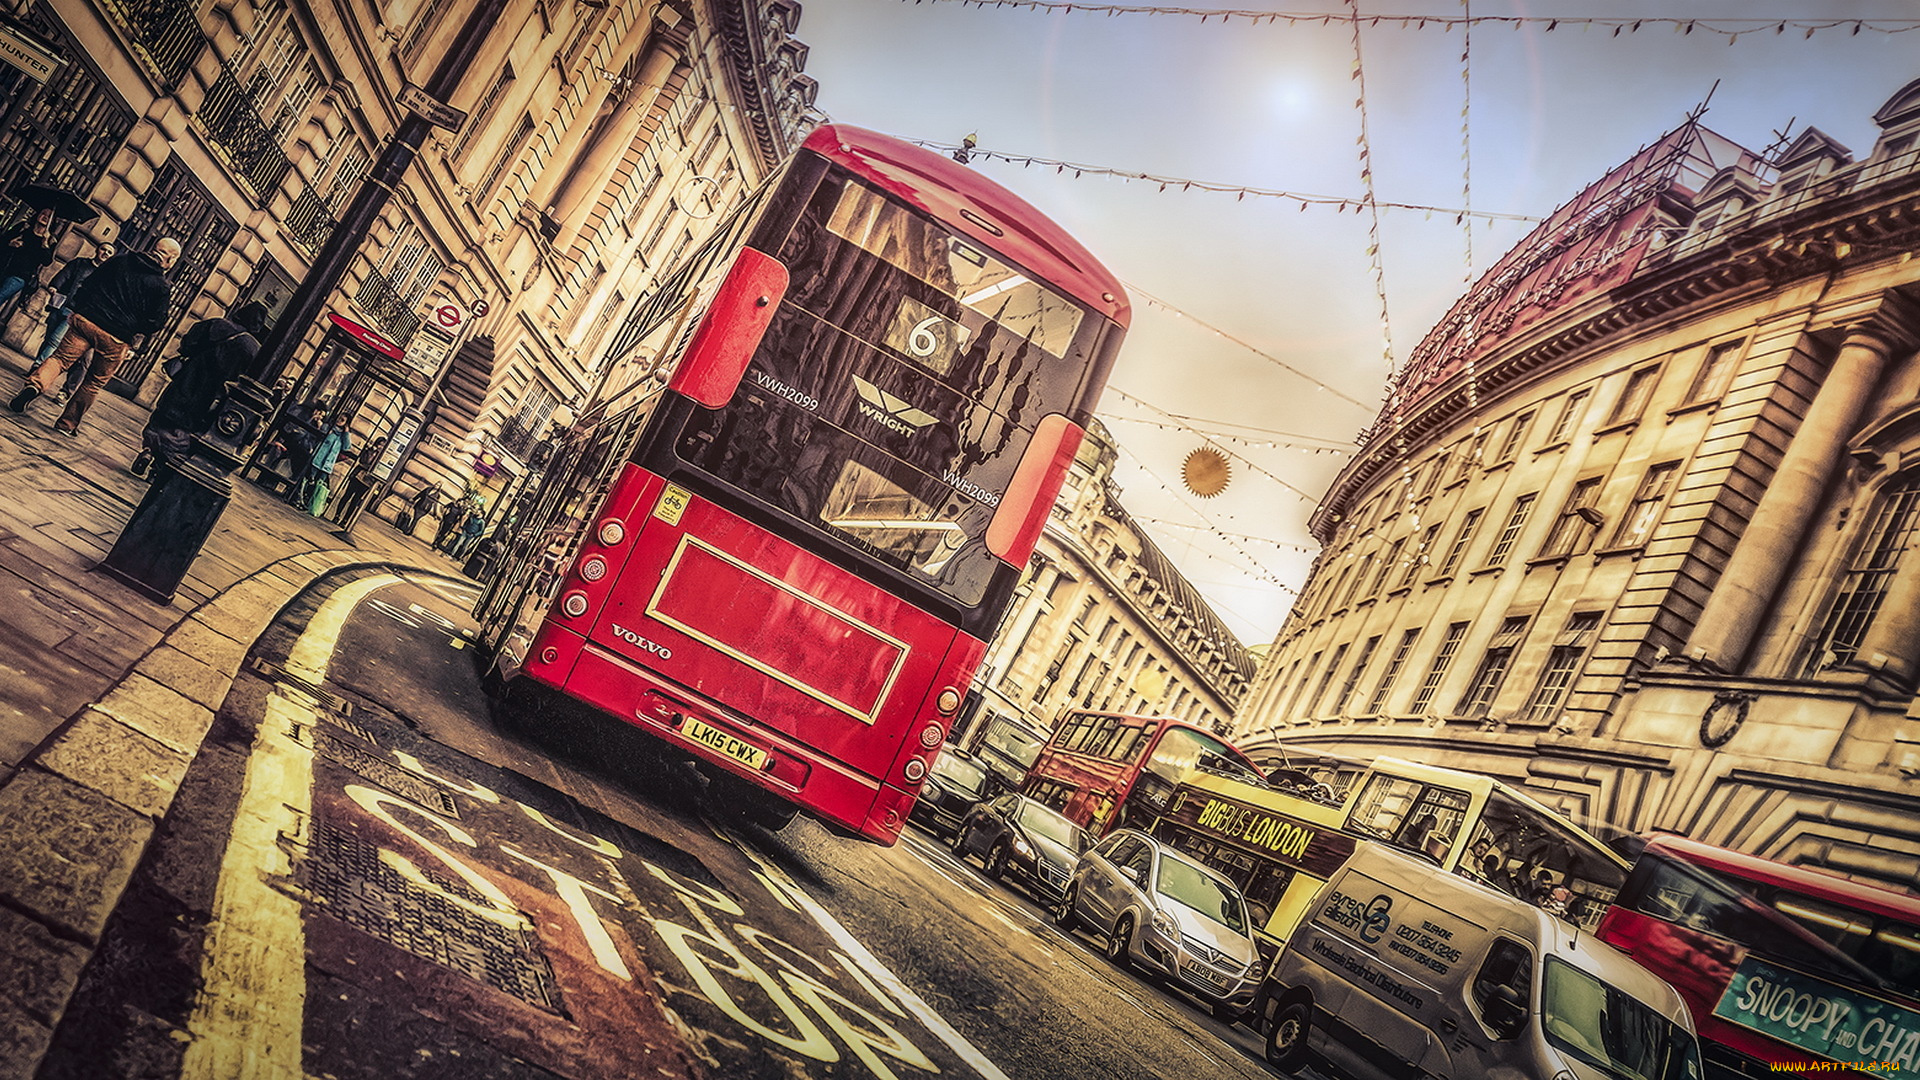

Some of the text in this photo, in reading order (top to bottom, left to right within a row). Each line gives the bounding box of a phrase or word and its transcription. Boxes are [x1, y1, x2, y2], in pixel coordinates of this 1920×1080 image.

[0, 38, 49, 75] HUNTER
[413, 91, 427, 104] No
[472, 303, 485, 317] E
[909, 316, 943, 357] 6
[757, 371, 819, 412] VWH2099
[858, 401, 916, 439] WRIGHT
[943, 469, 1000, 508] VWH2099
[611, 623, 673, 660] VOLVO
[691, 722, 758, 764] LK15 CWX
[1242, 813, 1315, 861] LONDON
[1330, 890, 1358, 911] eyre
[344, 783, 941, 1080] STOP
[1395, 924, 1463, 964] 0207 354 3245
[1736, 975, 1920, 1074] SNOOPY AND CHA
